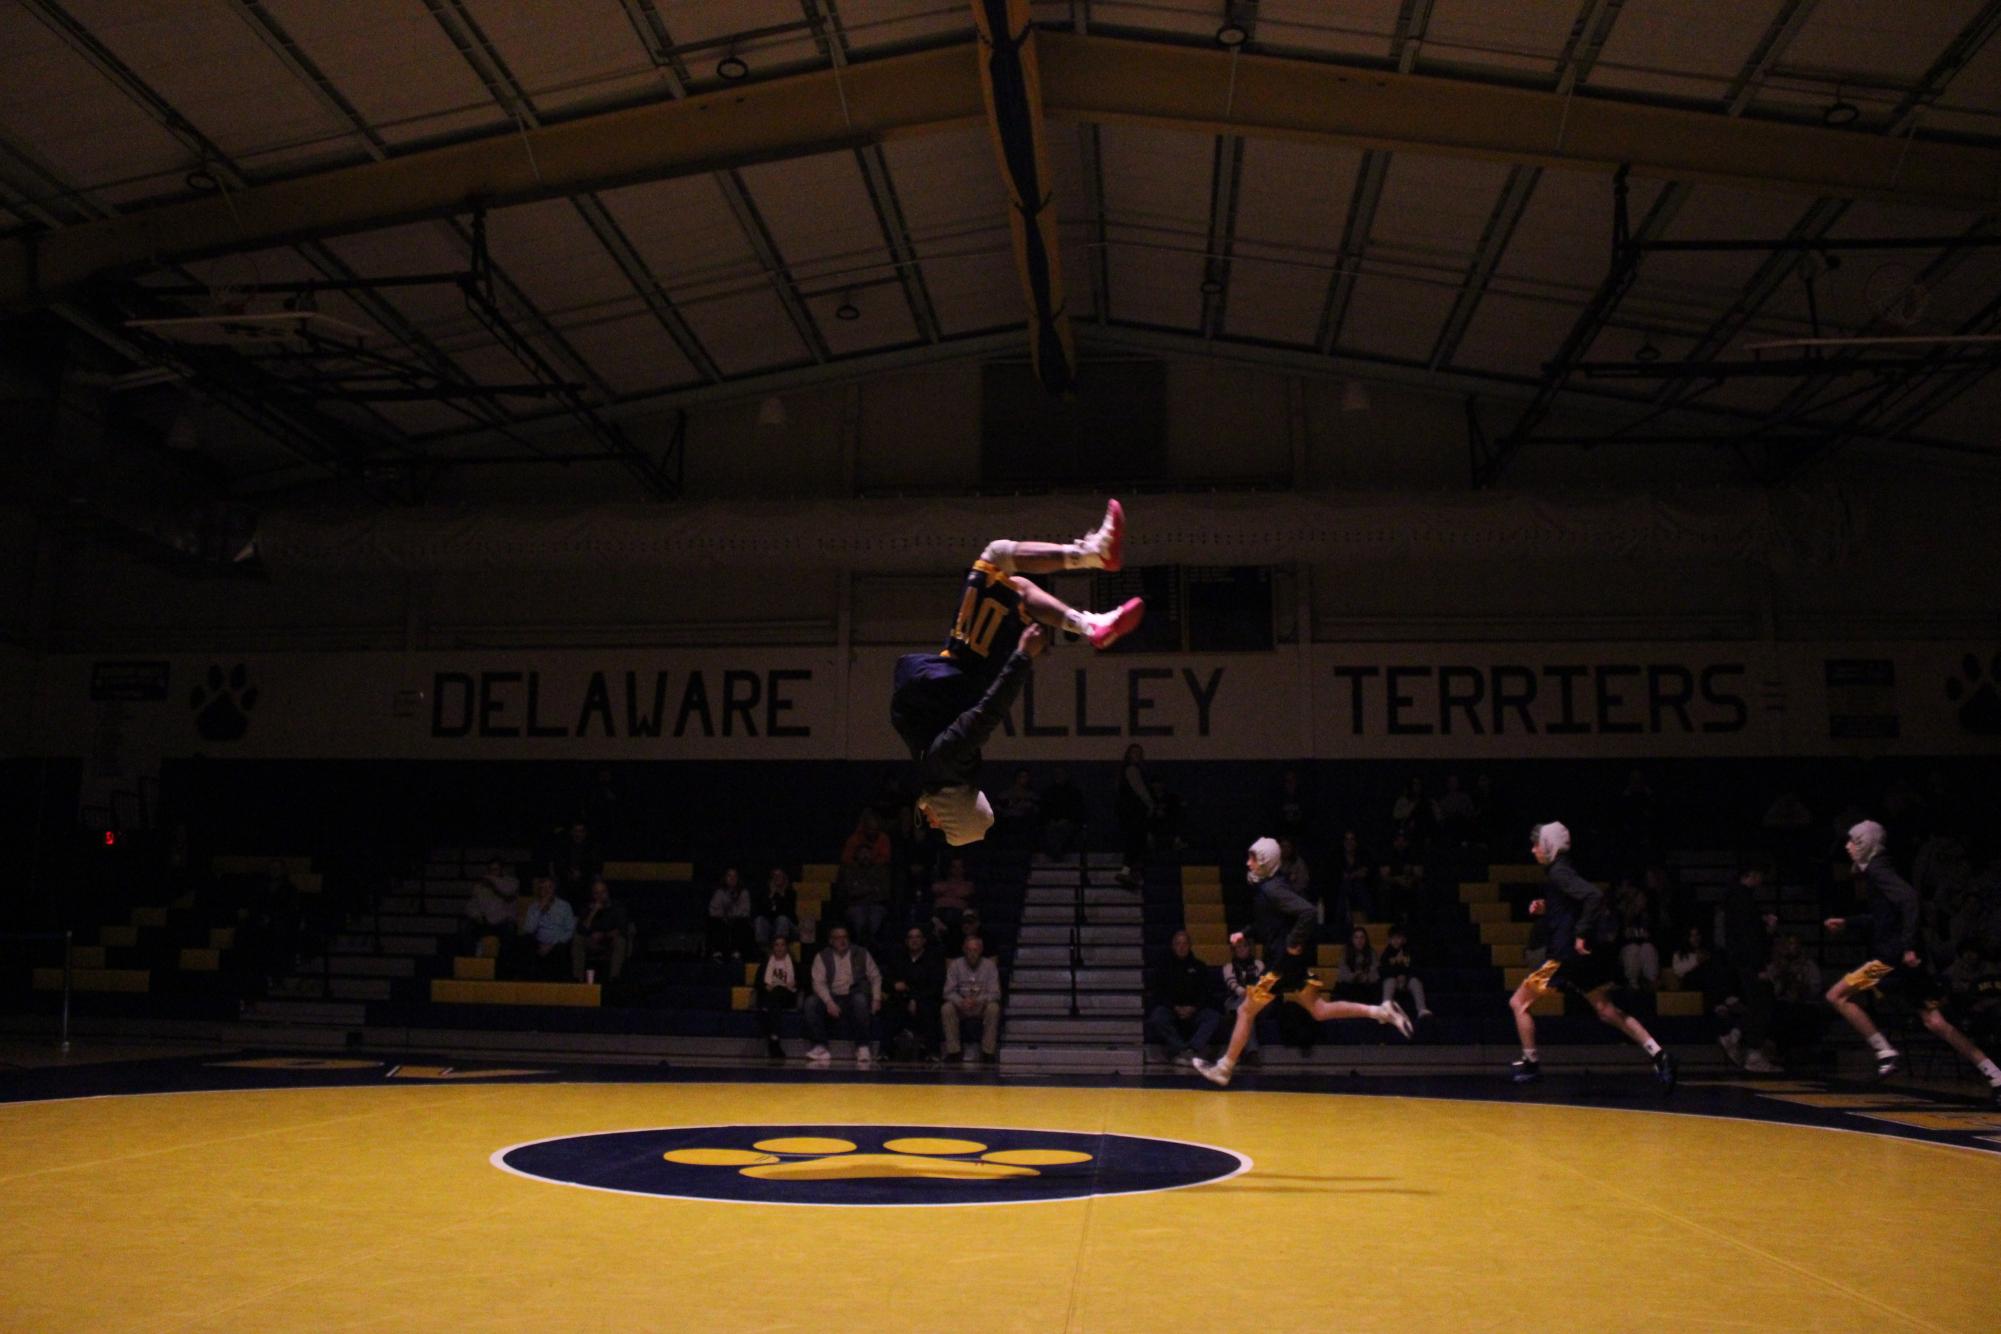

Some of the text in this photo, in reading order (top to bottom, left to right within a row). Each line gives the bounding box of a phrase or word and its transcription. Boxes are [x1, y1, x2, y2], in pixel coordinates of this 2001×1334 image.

[431, 663, 1748, 738] DELAWARE LLEY TERRIERS
